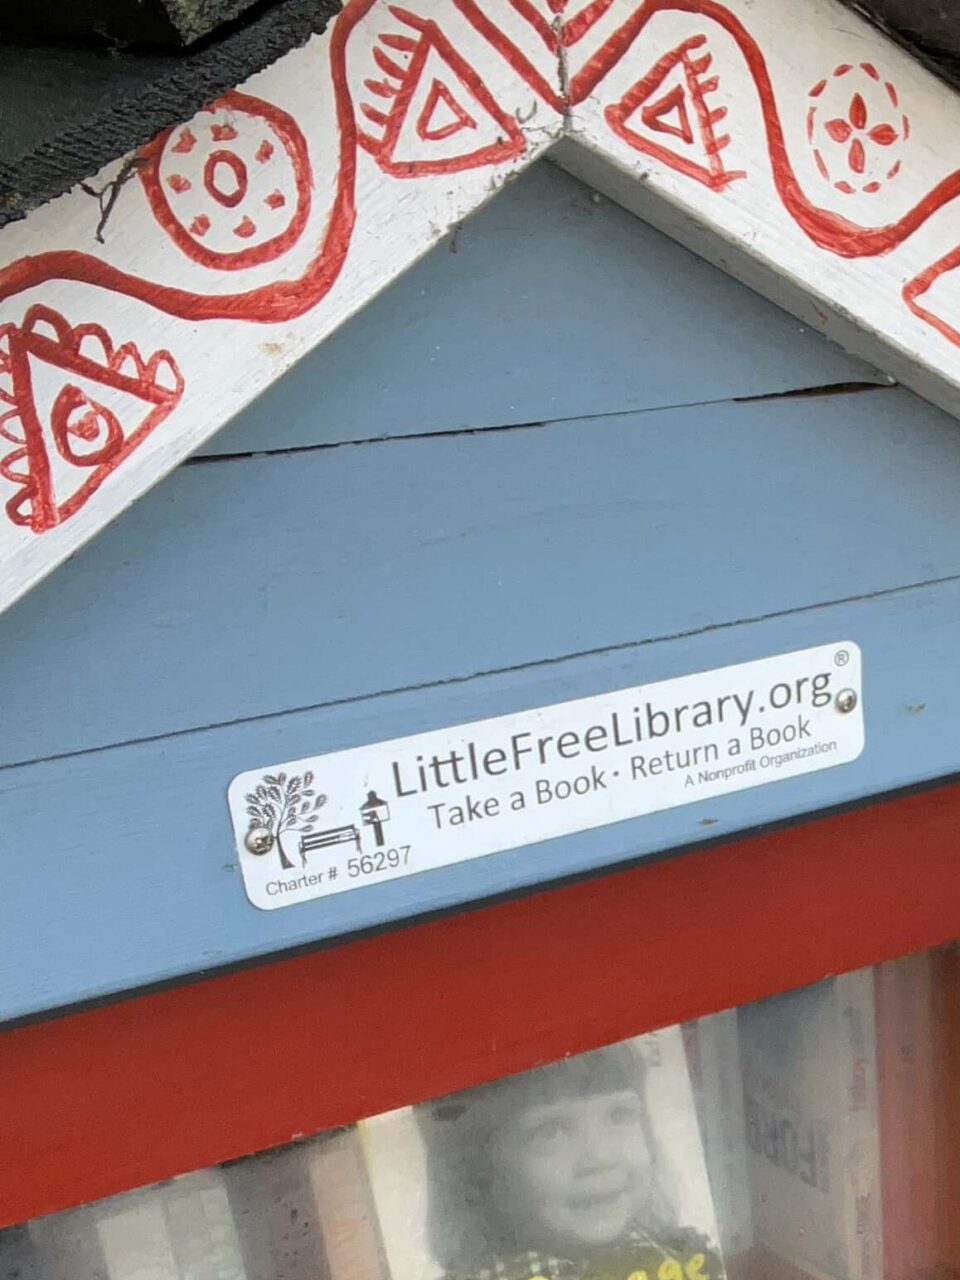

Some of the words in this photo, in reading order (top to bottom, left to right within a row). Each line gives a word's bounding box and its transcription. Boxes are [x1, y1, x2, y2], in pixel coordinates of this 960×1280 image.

[392, 672, 832, 797] LittleFreeLibrary.org
[427, 795, 499, 829] Take
[510, 791, 525, 811] a
[536, 765, 606, 806] Book
[630, 743, 718, 780] Return
[728, 737, 740, 756] a
[750, 715, 811, 751] Book
[684, 774, 694, 788] A
[698, 759, 756, 785] Nonprofit
[760, 740, 837, 769] Organization
[266, 871, 323, 896] Charter
[329, 866, 338, 880] #
[348, 845, 412, 878] 56297
